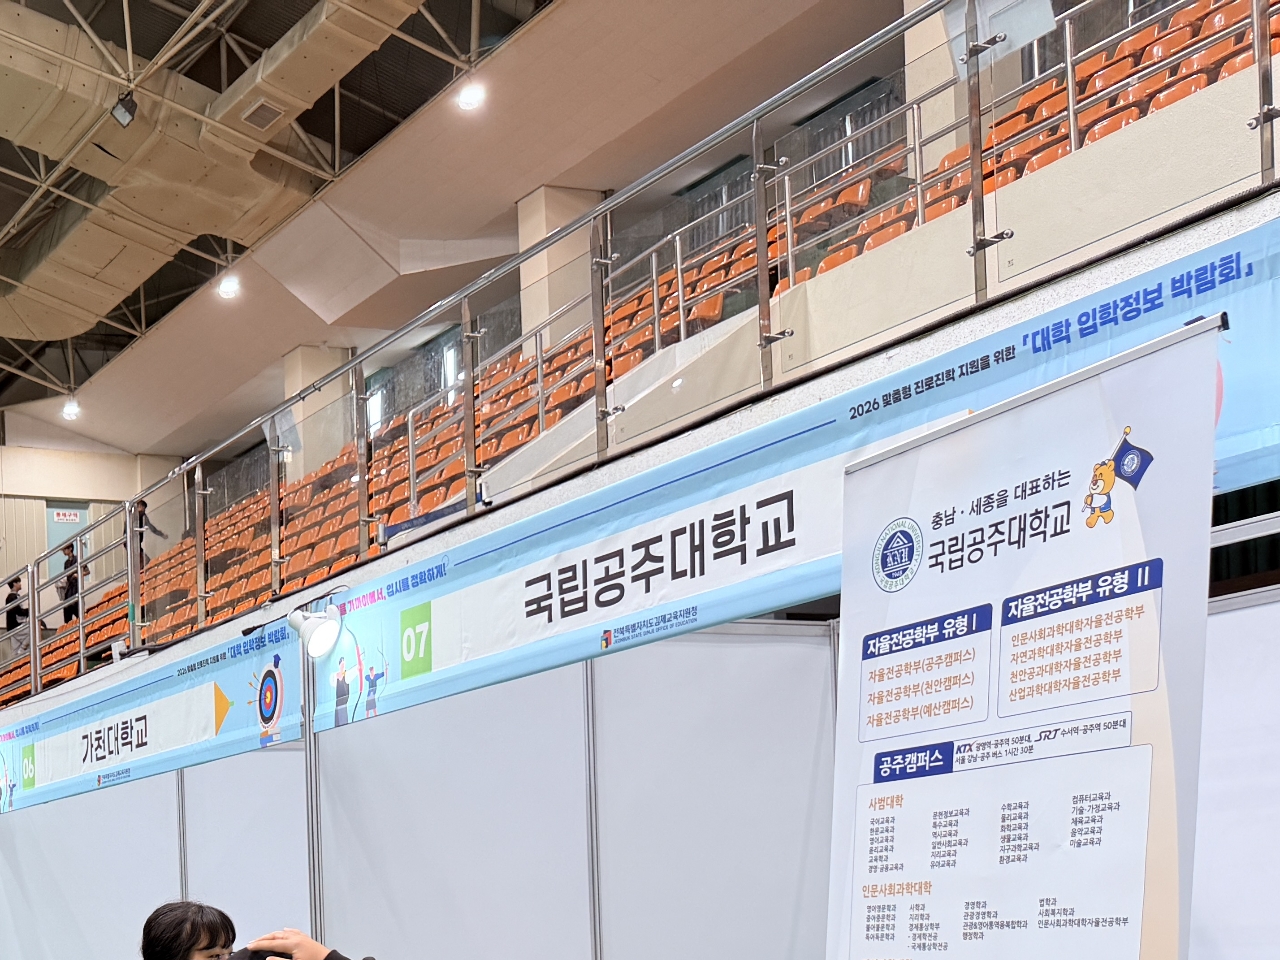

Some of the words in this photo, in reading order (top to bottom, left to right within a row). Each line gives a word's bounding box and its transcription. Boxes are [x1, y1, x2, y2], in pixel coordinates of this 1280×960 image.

[849, 398, 880, 420] 2026
[882, 383, 912, 408] 맞춤형
[914, 367, 956, 395] 진로진학
[957, 354, 991, 378] 지원을
[993, 344, 1016, 365] 위한
[1077, 281, 1164, 339] 입학정보
[931, 506, 956, 531] 충남
[969, 489, 1009, 516] 세종을
[1013, 469, 1071, 501] 대표하는
[880, 520, 907, 542] NATIONAL
[907, 522, 922, 563] UNIVERSITY
[928, 500, 1071, 573] 국립공주대학교
[524, 488, 797, 625] 국립공주대학교
[386, 577, 411, 597] 입시를
[410, 563, 447, 588] 정확하게!
[1008, 582, 1093, 620] 자율전공학부
[1095, 571, 1129, 594] 유형
[402, 621, 430, 662] 07
[867, 623, 939, 656] 자율전공학부
[943, 615, 969, 638] 유형
[1011, 604, 1145, 647] 인문사회과학대학자율전공학부
[1010, 629, 1123, 664] 자연과학대학자율전공학부
[868, 647, 976, 682] 자율전공학부(공주캠퍼스)
[1009, 648, 1123, 683] 천안공과대학자율전공학부
[867, 671, 975, 706] 자율전공학부(천안캠퍼스)
[1008, 668, 1122, 702] 산업과학대학자율전공학부
[866, 696, 974, 728] 자율전공학부(예산캠퍼스)
[82, 714, 148, 764] 가천대학교
[878, 750, 944, 777] 공주캠퍼스
[955, 740, 978, 755] KTX
[1034, 727, 1061, 742] SRT
[1060, 722, 1101, 737] 수서역-공주역
[1102, 718, 1127, 731] 50분대
[955, 754, 966, 765] 서울
[991, 747, 1003, 759] 버스
[1004, 747, 1019, 757] 1시간
[1020, 744, 1034, 755] 30분
[23, 756, 34, 779] 06
[868, 793, 904, 811] 사범대학
[1072, 791, 1111, 805] 컴퓨터교육과
[1070, 814, 1104, 826] 체육교육과
[1070, 825, 1103, 838] 음악교육과
[999, 842, 1040, 854] 지구과학교육과
[1069, 836, 1102, 848] 미술교육과
[862, 881, 933, 898] 인문사회과학대학
[964, 900, 987, 911] 경영학과
[1038, 897, 1057, 908] 법학과
[909, 903, 926, 912] 사학과
[909, 913, 930, 921] 지리학과
[963, 911, 998, 920] 관광경영학과
[1037, 907, 1075, 918] 사회복지학과
[1037, 916, 1129, 929] 인문사회과학대학자율전공학부
